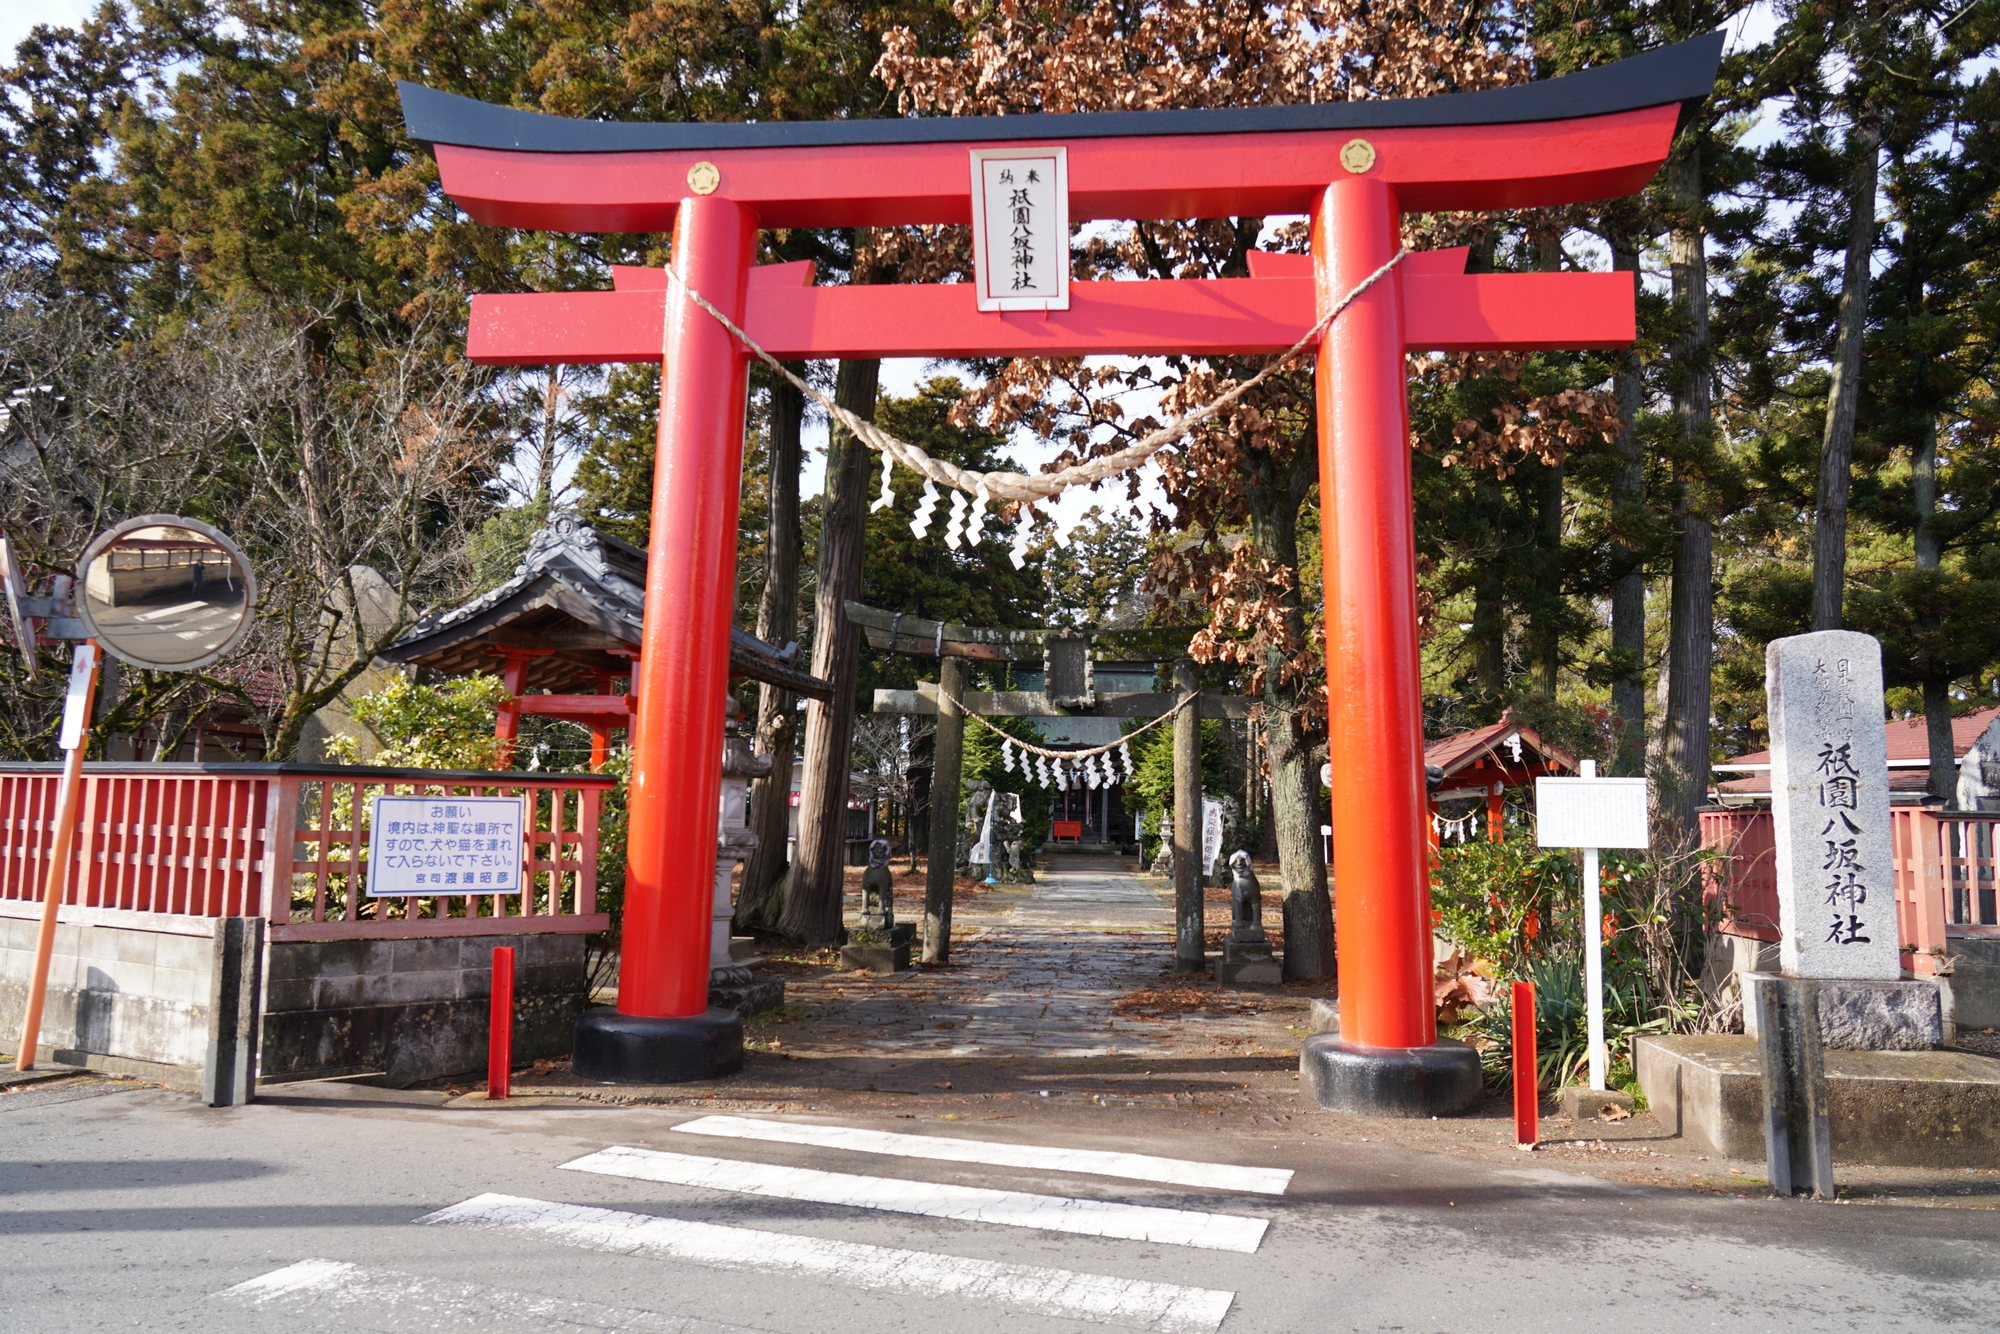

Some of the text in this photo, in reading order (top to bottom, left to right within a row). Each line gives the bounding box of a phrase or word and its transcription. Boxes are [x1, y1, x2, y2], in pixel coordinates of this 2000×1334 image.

[430, 806, 471, 819] お願い
[387, 821, 513, 835] 境内は、神聖な場所で
[385, 838, 512, 852] すので、犬や猫を連れ
[384, 854, 513, 869] て入らないで下さい。
